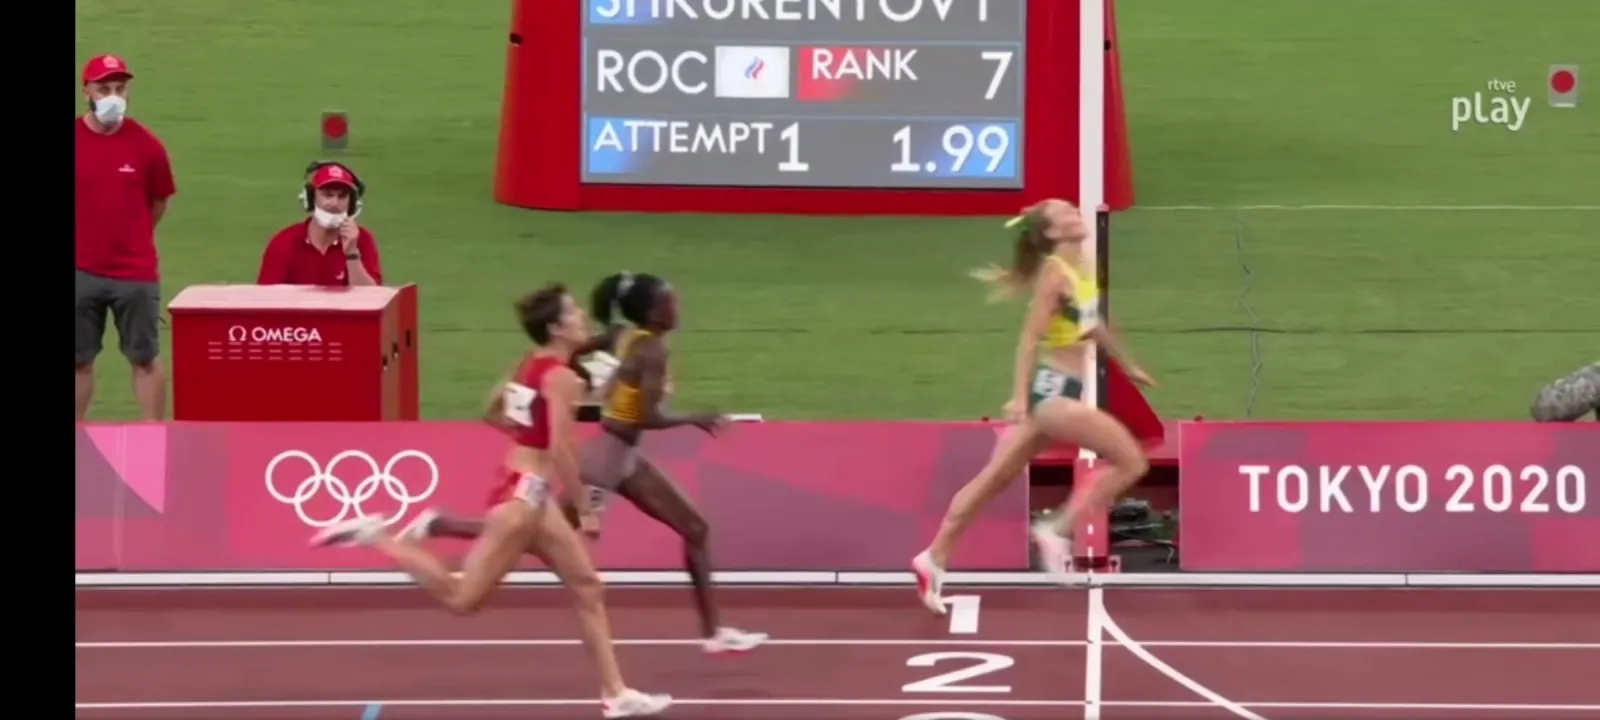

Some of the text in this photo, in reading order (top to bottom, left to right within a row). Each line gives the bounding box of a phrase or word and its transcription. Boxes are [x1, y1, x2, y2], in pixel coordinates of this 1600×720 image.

[597, 49, 1013, 100] ROC RANK 7
[594, 121, 1009, 172] ATTEMPT 1 1.99
[251, 327, 322, 342] OMEGA
[1239, 465, 1586, 513] TOKYO 2020
[941, 595, 981, 633] 1
[902, 652, 1015, 692] 2
